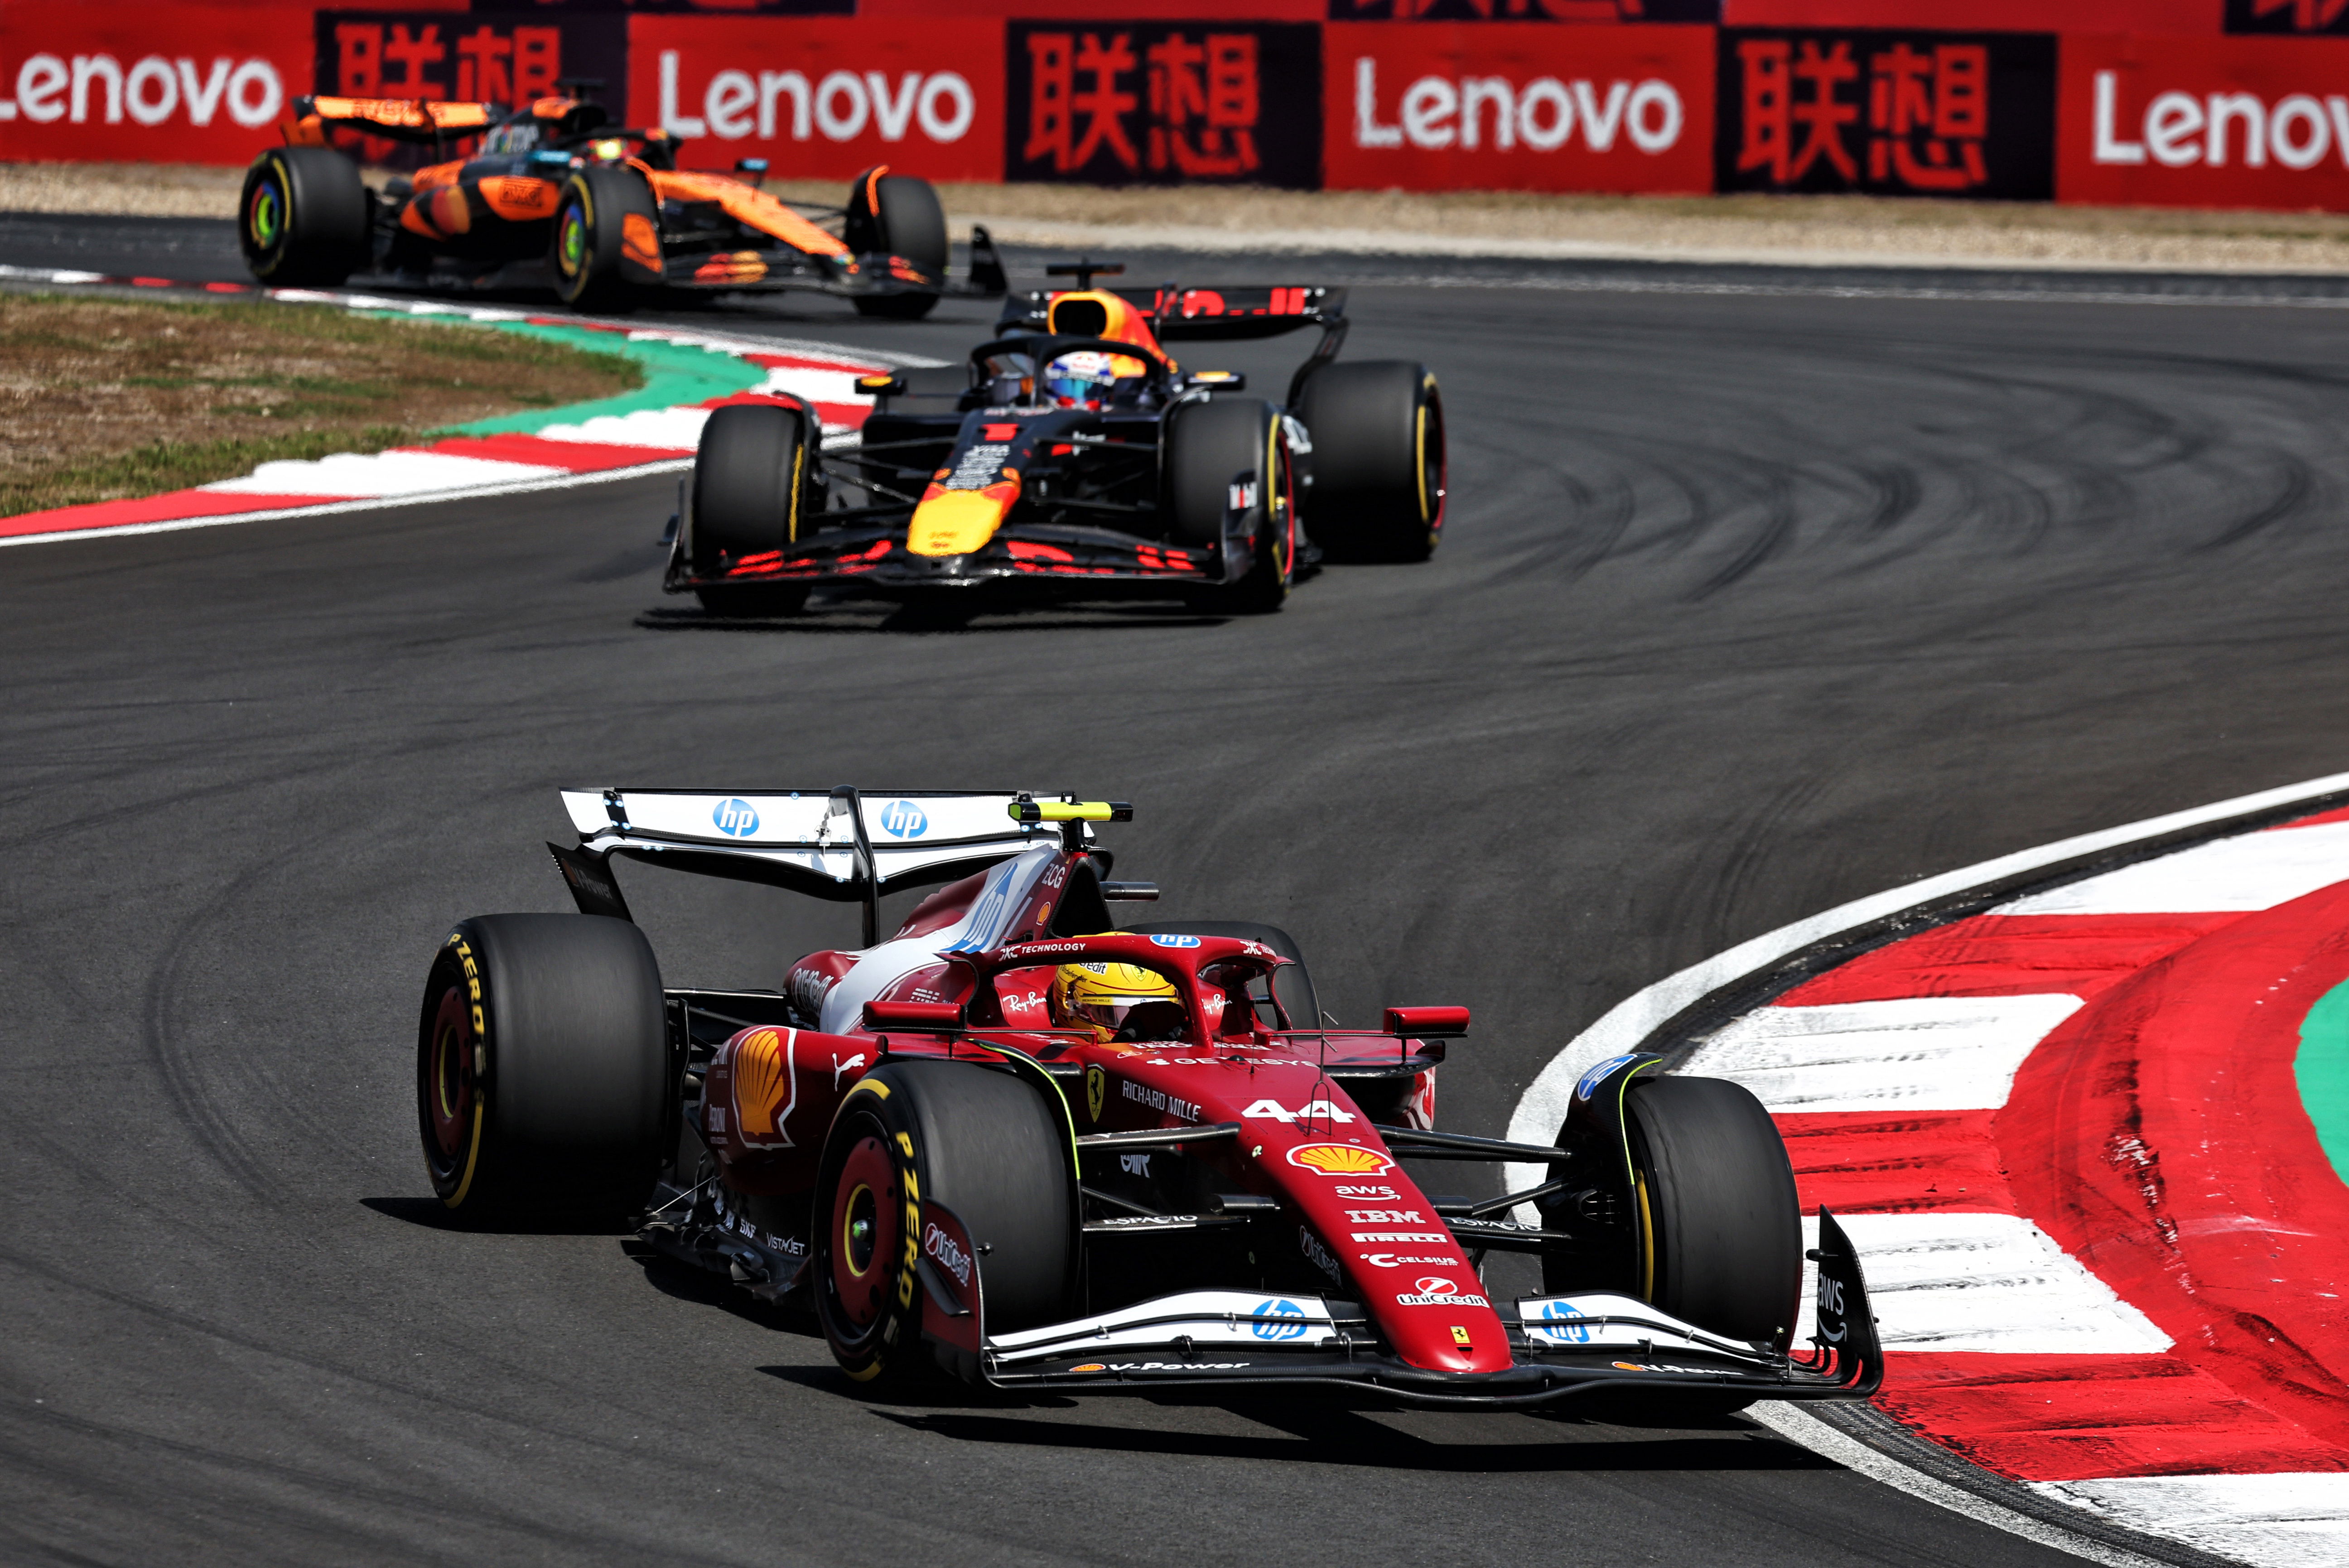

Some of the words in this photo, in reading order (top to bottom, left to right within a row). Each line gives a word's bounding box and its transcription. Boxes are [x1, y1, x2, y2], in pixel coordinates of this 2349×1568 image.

[658, 49, 975, 143] Lenovo
[1025, 32, 1259, 174] 联想
[1355, 57, 1684, 154] Lenovo
[1738, 39, 1990, 188] 联想
[721, 799, 755, 837] hp
[889, 801, 922, 839] hp
[1021, 943, 1086, 954] TECHNOLOGY
[457, 941, 485, 1035] ZERO
[1123, 1080, 1166, 1111] RICHARD
[1167, 1096, 1202, 1122] MILLE
[1241, 1099, 1356, 1123] 44
[1334, 1185, 1396, 1195] aws
[739, 1218, 757, 1239] SKF
[1344, 1210, 1426, 1223] IBM
[899, 1168, 920, 1309] ZERO
[1350, 1232, 1448, 1243] PIRELLI
[1399, 1294, 1488, 1307] UniCredit
[1818, 1272, 1844, 1316] aws
[1109, 1361, 1250, 1371] V-Power
